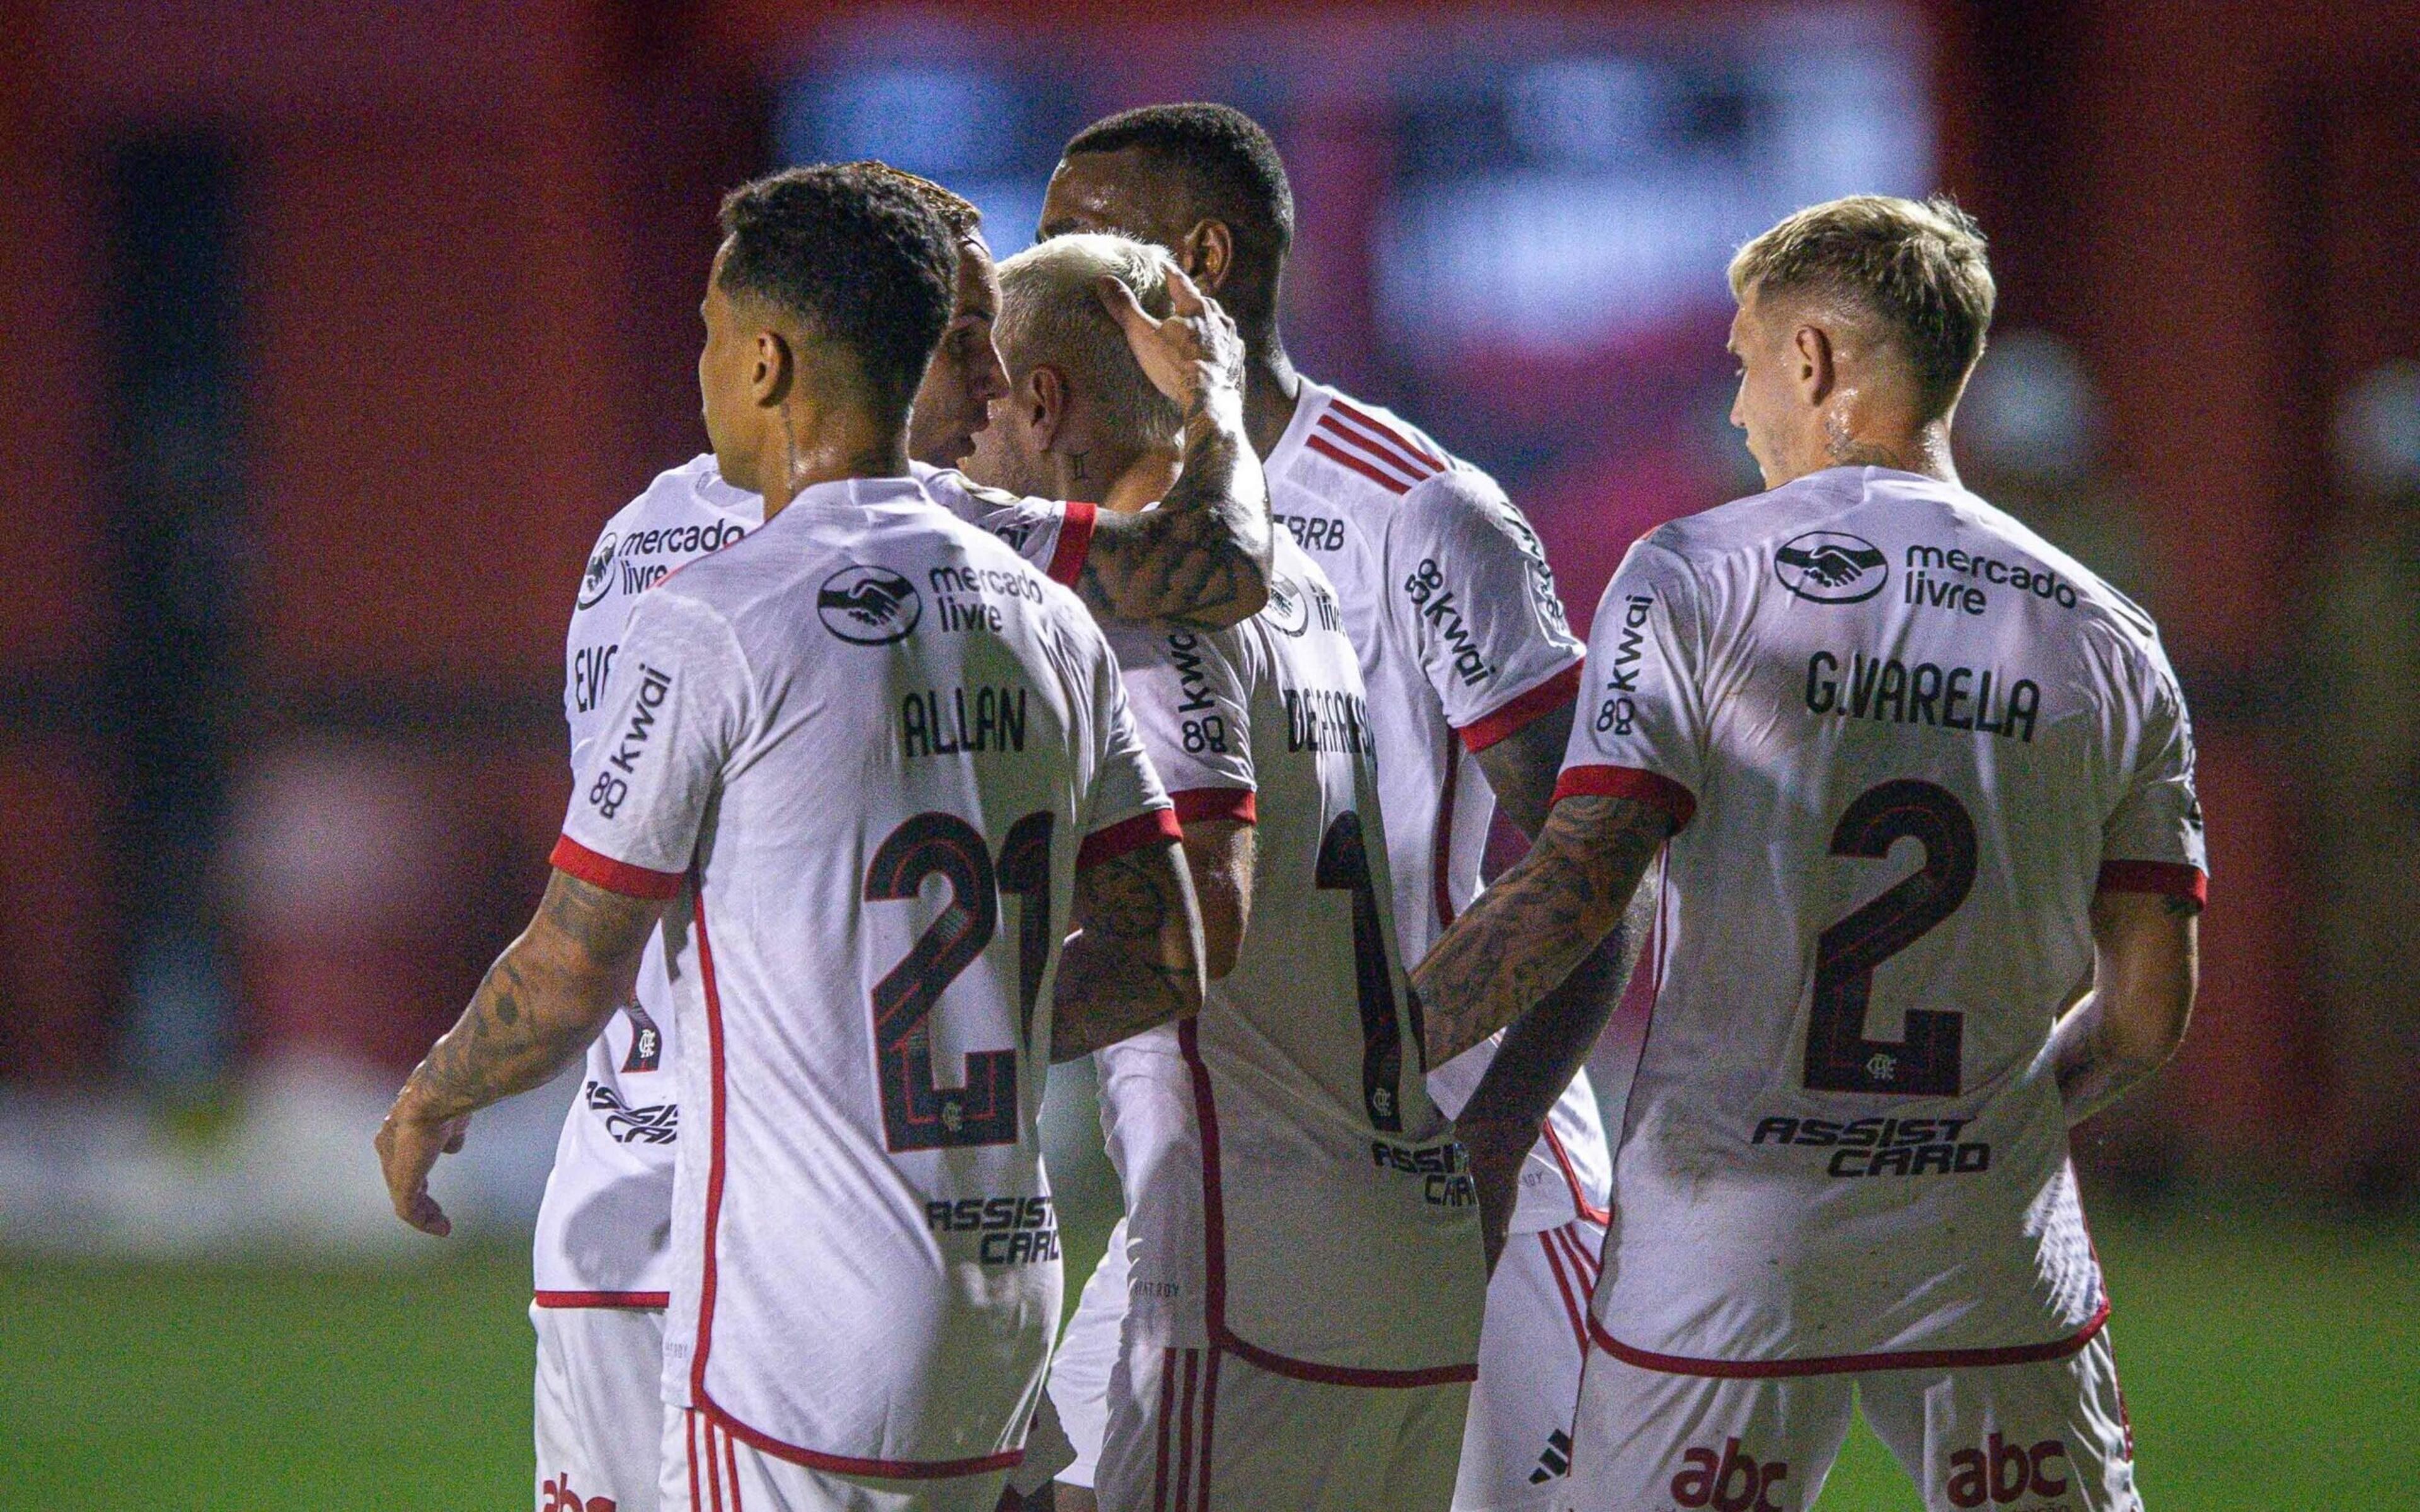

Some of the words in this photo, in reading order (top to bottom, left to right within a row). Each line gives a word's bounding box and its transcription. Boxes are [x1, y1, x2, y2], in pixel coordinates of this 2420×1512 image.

[618, 518, 745, 556] mercado
[620, 559, 667, 595] livre
[929, 566, 1043, 605] mercado
[1904, 571, 1986, 616] livre
[1906, 544, 2077, 609] mercado
[938, 596, 1003, 633] livre
[903, 686, 1026, 756] ALLAN
[1806, 650, 2040, 743] G.VARELA
[1804, 779, 1978, 1097] 2
[863, 811, 1054, 1154] 21
[1751, 1116, 1978, 1149] ASSIST
[1829, 1142, 1991, 1177] CARD
[1671, 1435, 1788, 1512] abc
[1947, 1433, 2067, 1508] abc
